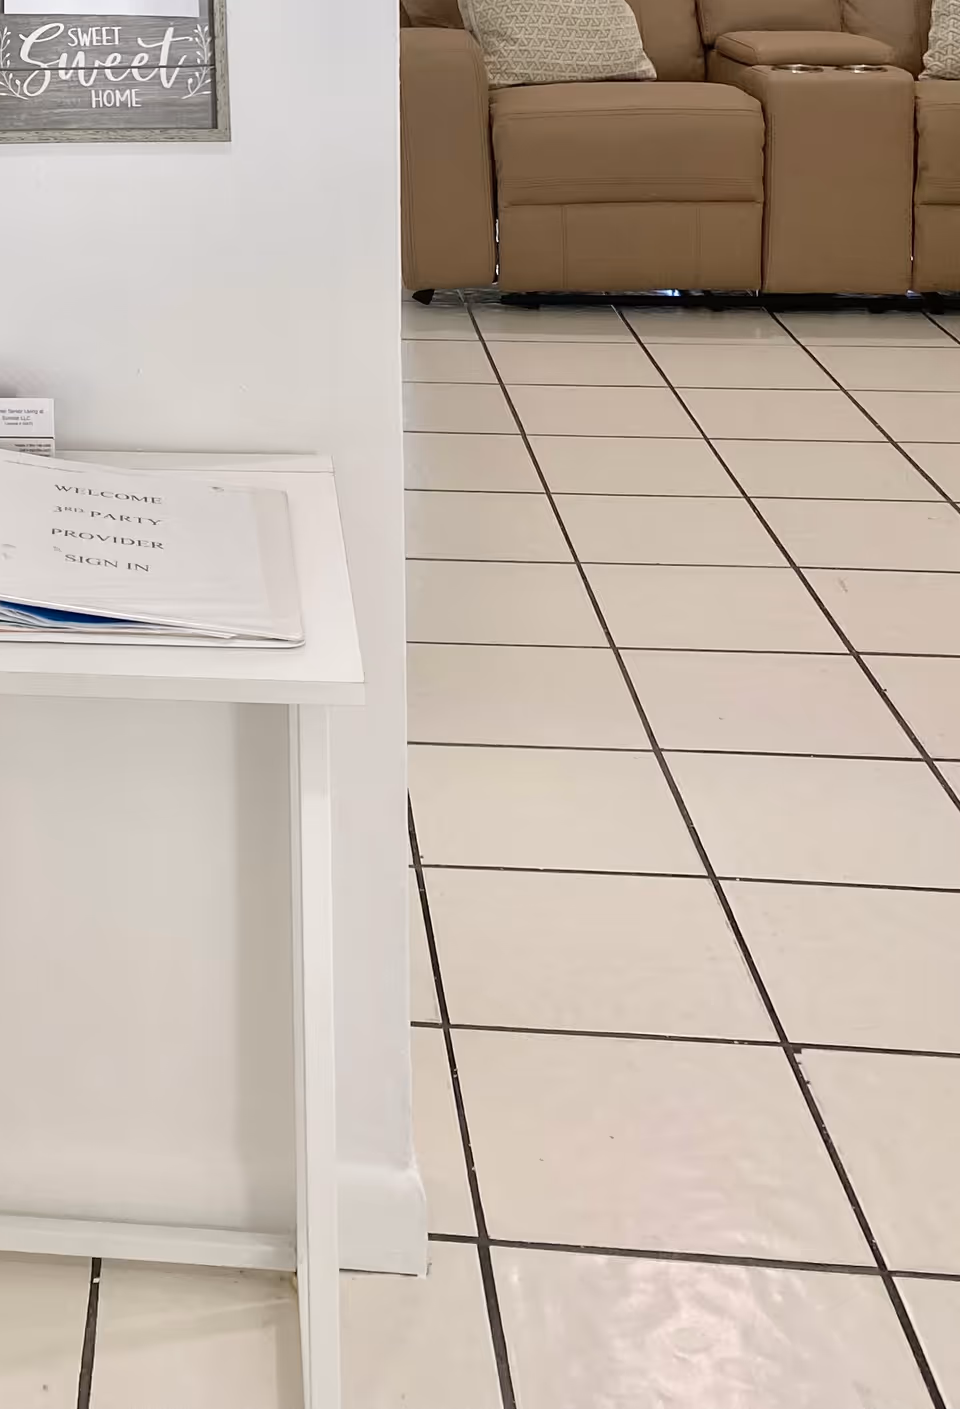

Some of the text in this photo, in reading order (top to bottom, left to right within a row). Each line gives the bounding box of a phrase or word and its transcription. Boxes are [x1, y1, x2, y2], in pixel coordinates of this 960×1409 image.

[67, 26, 122, 47] SWEET
[18, 22, 193, 97] Sweet
[91, 89, 142, 108] HOME
[54, 484, 164, 506] WELCOME
[89, 511, 164, 526] PARTY
[51, 528, 165, 550] PROVIDER
[64, 553, 150, 573] SIGN IN
